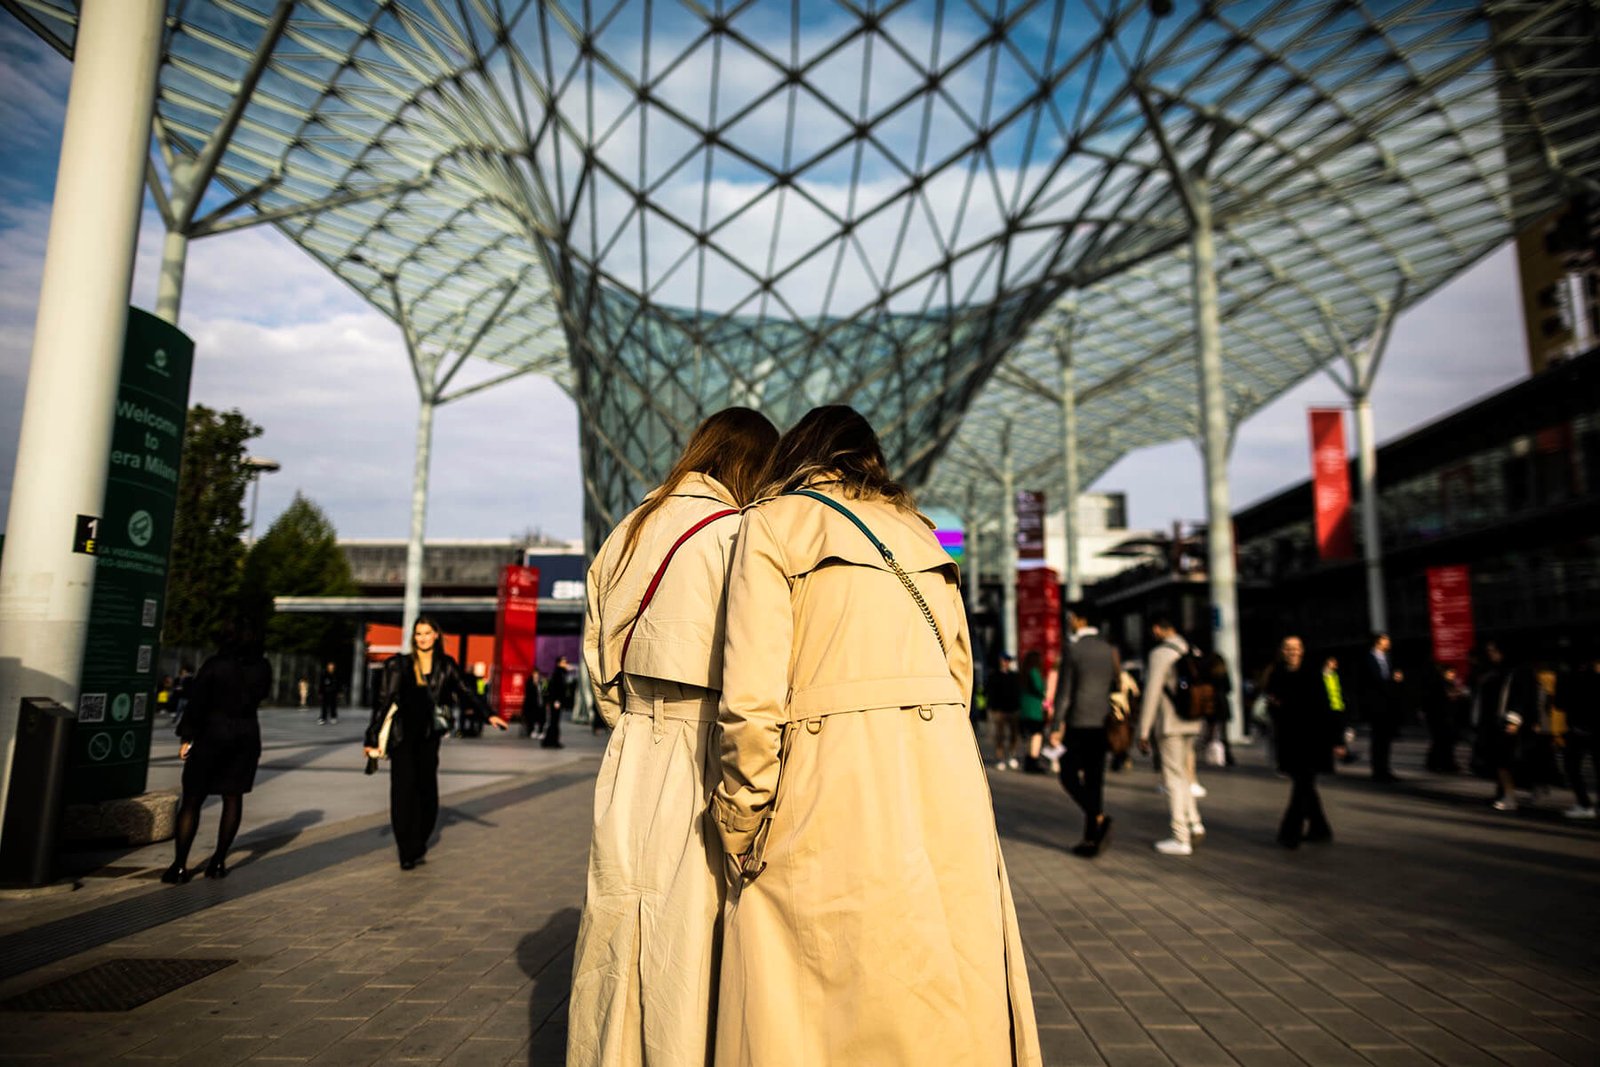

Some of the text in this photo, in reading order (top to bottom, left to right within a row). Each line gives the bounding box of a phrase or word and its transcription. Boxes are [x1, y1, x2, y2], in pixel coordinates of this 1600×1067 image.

[145, 431, 159, 450] to
[88, 519, 98, 539] 1
[85, 539, 96, 553] E
